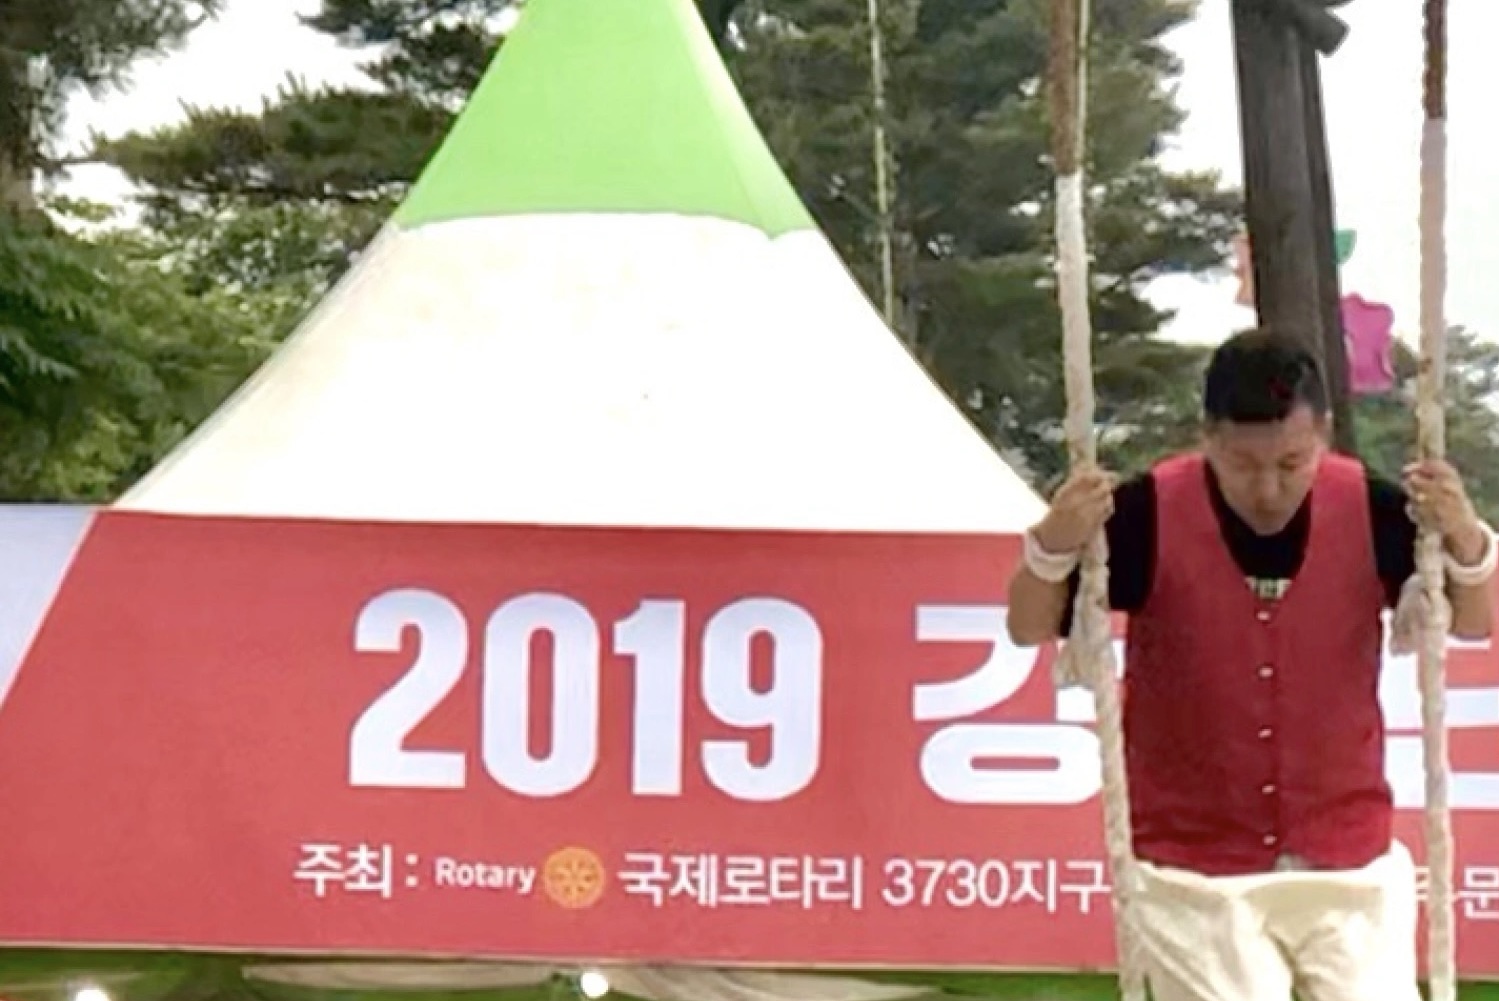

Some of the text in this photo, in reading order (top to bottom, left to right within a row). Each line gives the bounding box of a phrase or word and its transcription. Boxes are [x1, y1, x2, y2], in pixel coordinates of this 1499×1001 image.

[349, 587, 824, 801] 2019
[434, 855, 537, 895] Rotary
[616, 851, 864, 911] 국제로타리
[882, 856, 1112, 914] 3730지구
